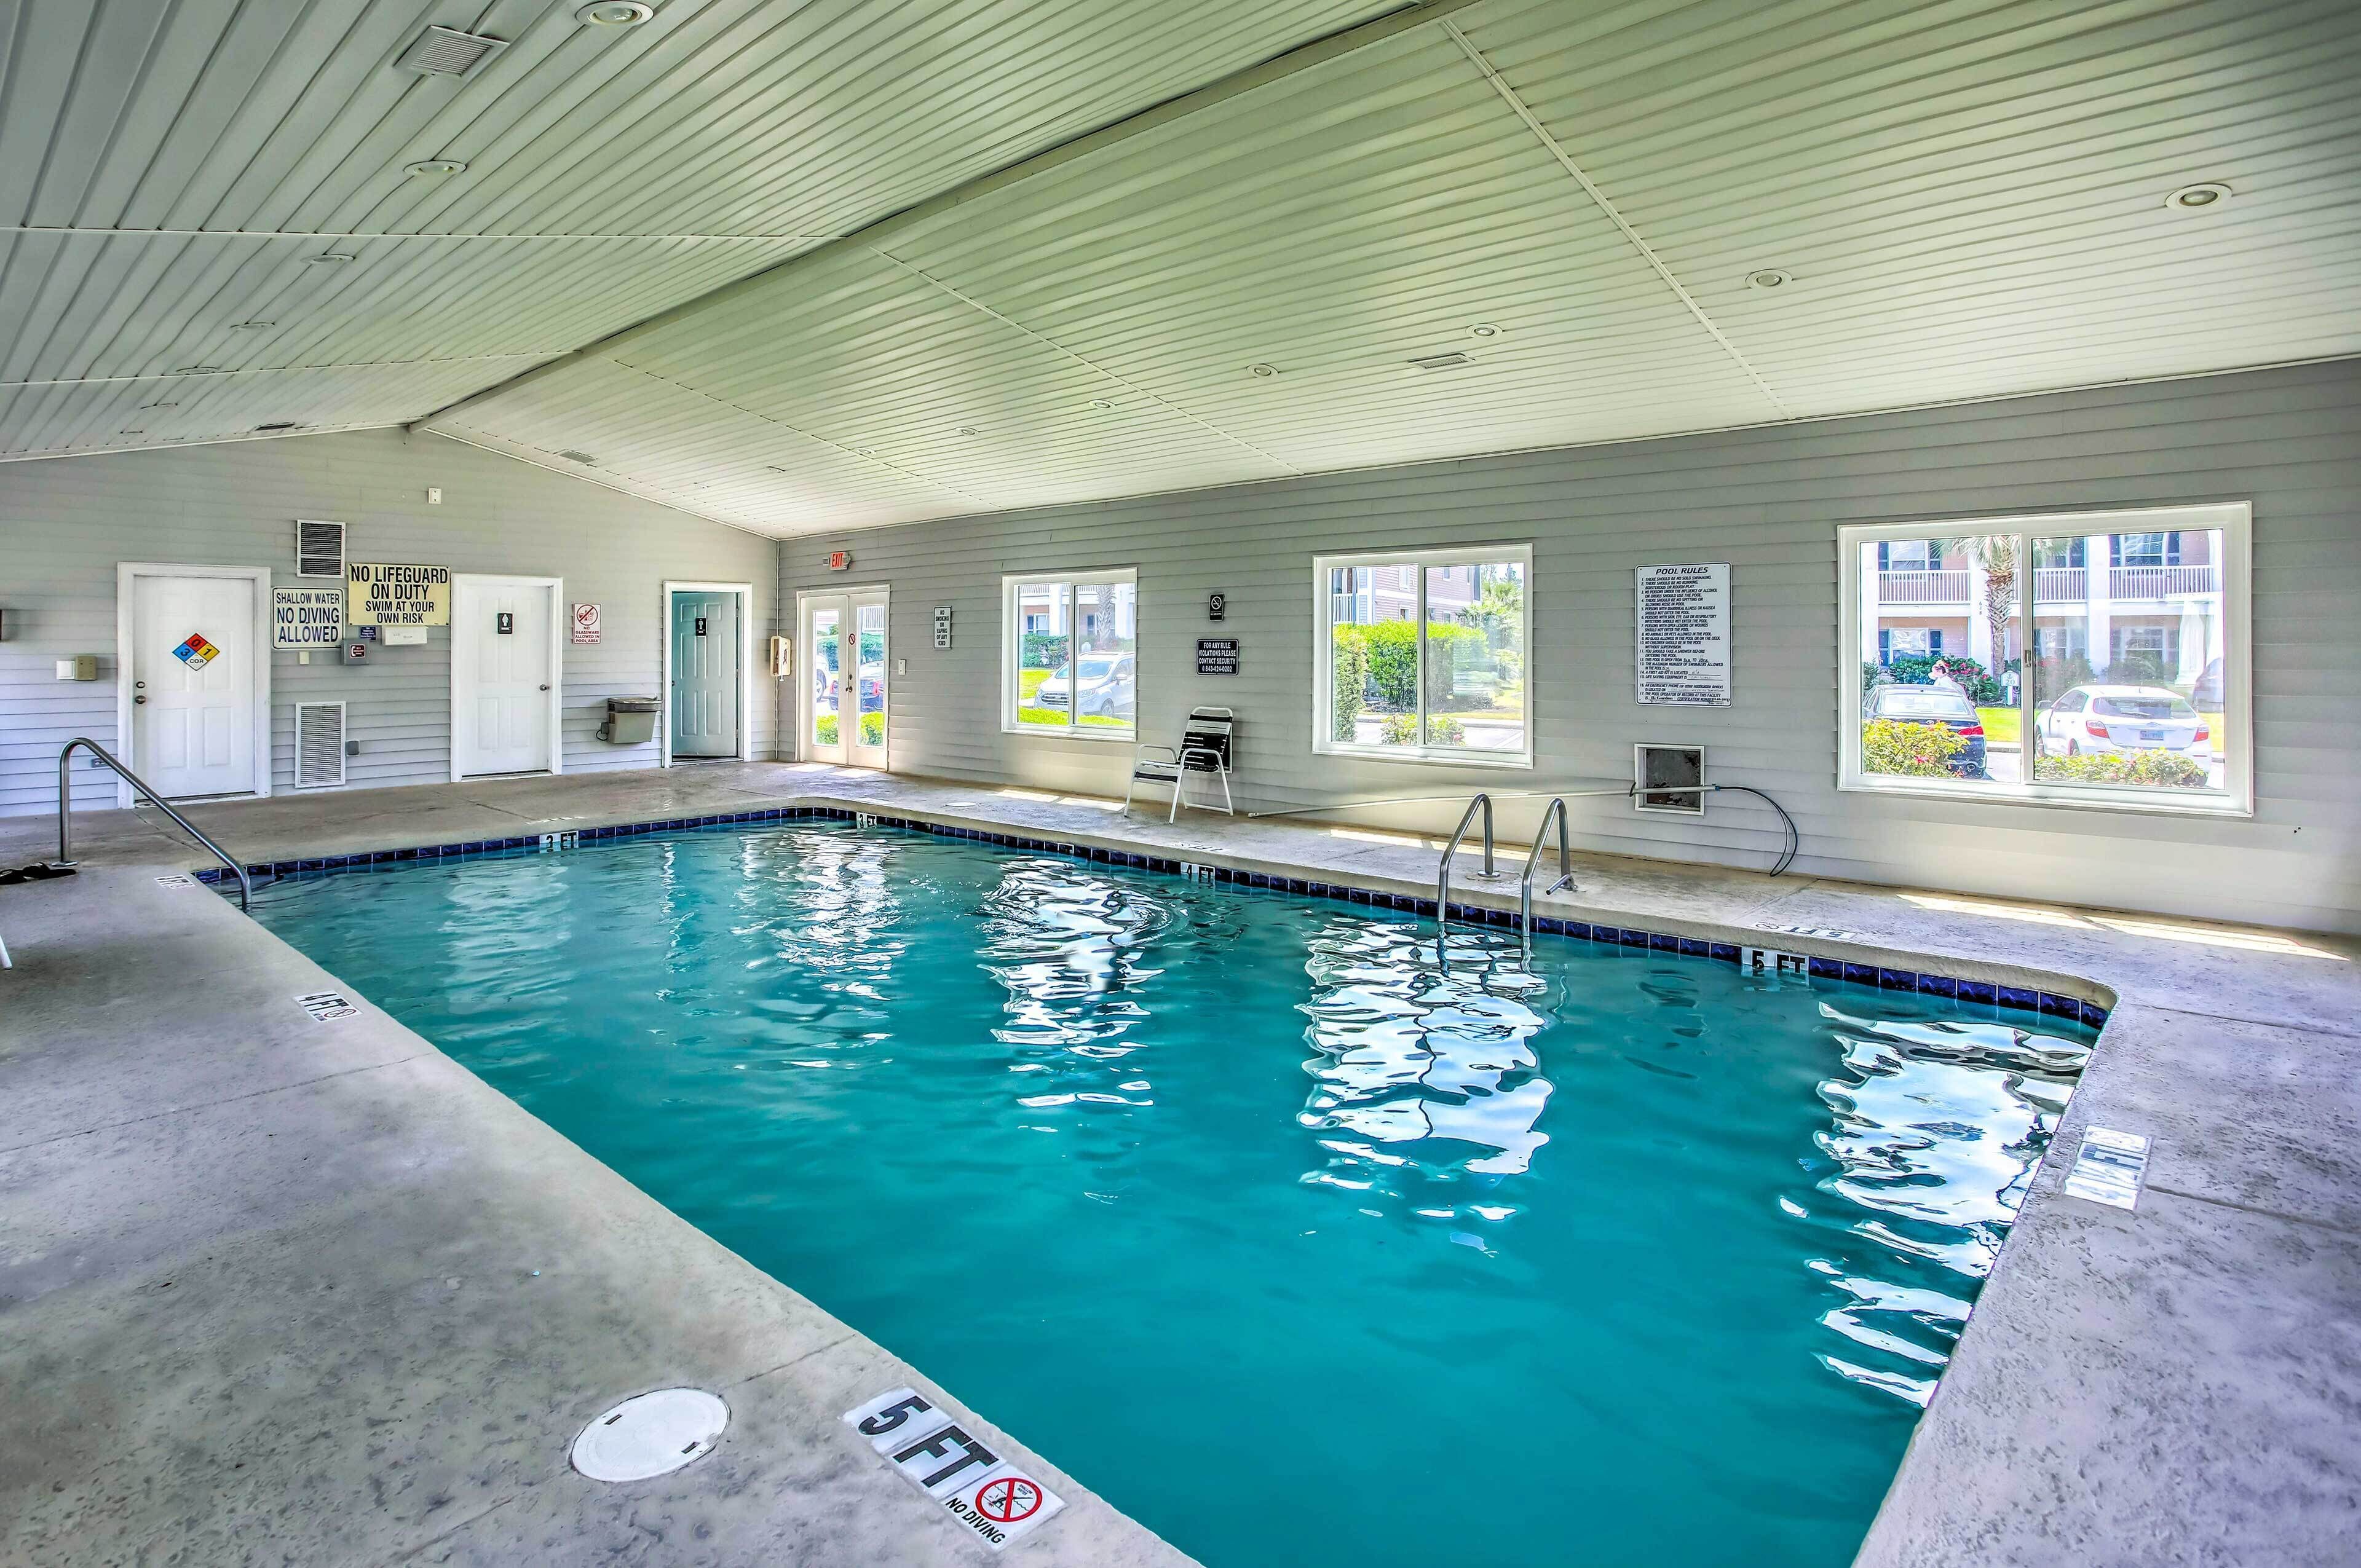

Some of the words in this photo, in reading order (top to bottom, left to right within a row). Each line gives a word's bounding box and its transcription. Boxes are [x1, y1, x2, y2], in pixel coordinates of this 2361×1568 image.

[832, 553, 843, 567] EXIT
[351, 565, 370, 582] NO
[375, 567, 448, 583] LIFEGUARD
[277, 593, 312, 604] SHALLOW
[315, 593, 339, 604] WATER
[371, 585, 389, 599] ON
[395, 585, 429, 600] DUTY
[366, 601, 392, 612] SWIM
[395, 601, 406, 612] AT
[410, 602, 434, 612] YOUR
[277, 607, 294, 623] NO
[299, 608, 339, 623] DIVING
[377, 613, 398, 623] OWN
[403, 613, 424, 623] RISK
[279, 626, 339, 642] ALLOWED
[1784, 926, 1817, 935] FT
[1752, 950, 1765, 969] 5
[1776, 954, 1806, 973] FT
[298, 993, 338, 1002] 4
[304, 998, 349, 1011] FT
[2081, 1144, 2144, 1170] FT
[858, 1395, 932, 1435] 5
[892, 1425, 999, 1488] FT
[946, 1497, 968, 1513] NO
[962, 1511, 1005, 1543] DIVING
